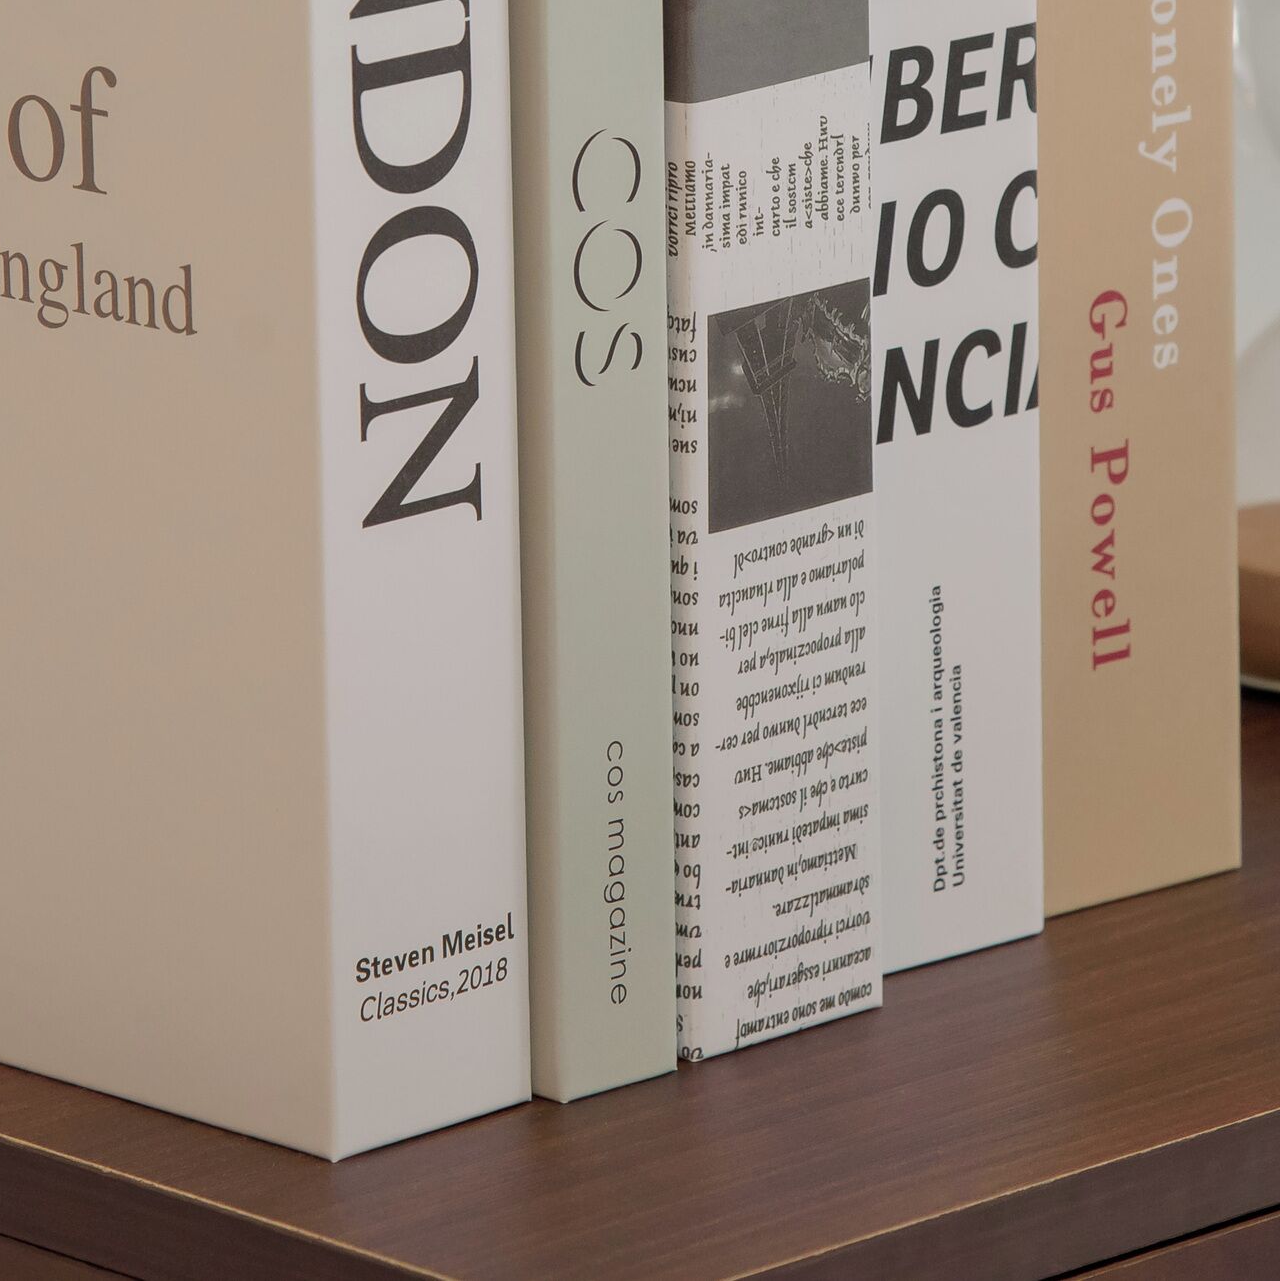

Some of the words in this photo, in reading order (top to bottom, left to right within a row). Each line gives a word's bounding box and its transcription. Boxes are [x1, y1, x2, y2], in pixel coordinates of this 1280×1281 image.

[869, 22, 1037, 145] BER
[7, 65, 118, 196] of
[851, 134, 864, 160] per
[718, 162, 735, 211] impat
[735, 169, 748, 220] runico
[771, 184, 781, 193] e
[752, 205, 765, 237] int-
[770, 197, 781, 238] curto
[835, 197, 846, 222] ece
[718, 211, 732, 249] sima
[572, 127, 643, 387] COS
[1150, 194, 1194, 372] Ones
[1087, 288, 1131, 414] Gus
[809, 549, 864, 583] polariamo
[1090, 436, 1132, 672] Powell
[776, 574, 798, 602] alla
[801, 572, 807, 585] e
[792, 605, 814, 633] alla
[844, 626, 866, 653] alla
[928, 585, 945, 701] arqueologia
[737, 650, 757, 675] per
[850, 697, 867, 714] ece
[949, 665, 963, 745] valencia
[741, 721, 760, 746] per
[605, 740, 627, 805] cos
[951, 750, 964, 774] de
[830, 776, 836, 792] e
[838, 768, 868, 790] curto
[799, 786, 808, 813] il
[843, 804, 869, 826] sima
[951, 778, 966, 887] Universitat
[604, 818, 632, 1006] magazine
[355, 943, 435, 983] Steven
[442, 912, 515, 960] Meisel
[360, 957, 508, 1022] Classics,2018
[819, 994, 836, 1012] me
[792, 1001, 817, 1022] sono
